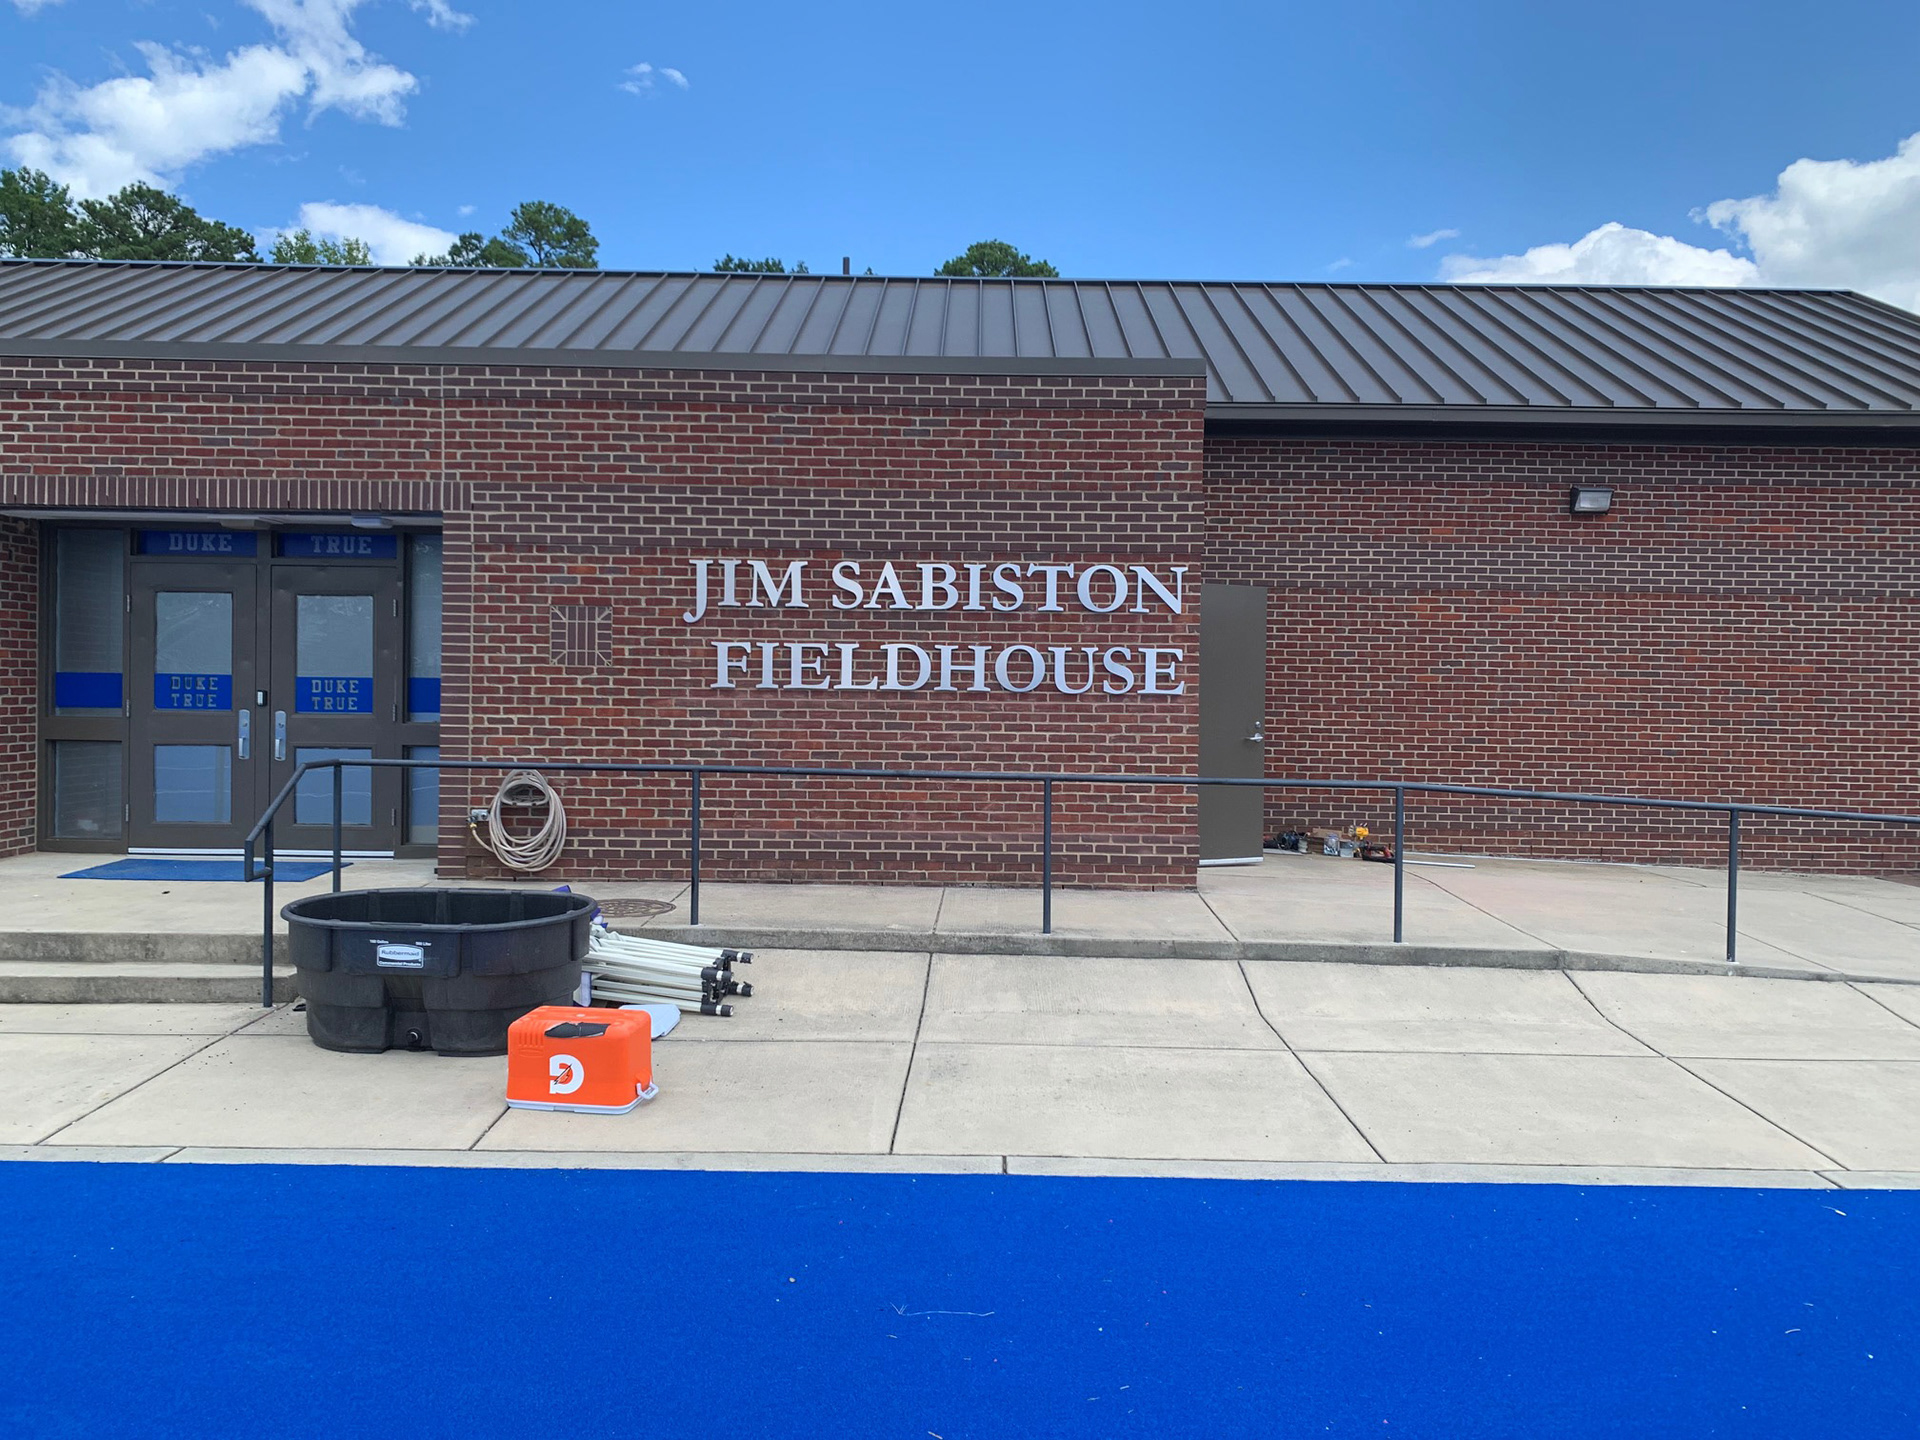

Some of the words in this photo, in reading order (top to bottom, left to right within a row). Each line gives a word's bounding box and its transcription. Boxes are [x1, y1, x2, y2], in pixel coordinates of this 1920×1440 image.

[168, 533, 232, 551] DUKE
[310, 536, 372, 554] TRUE
[683, 559, 808, 622] JIM
[832, 560, 1188, 614] SABISTON
[710, 641, 1184, 695] FIELDHOUSE
[171, 676, 218, 690] DUKE
[311, 680, 359, 693] DUKE
[171, 694, 216, 707] TRUE
[311, 697, 358, 710] TRUE
